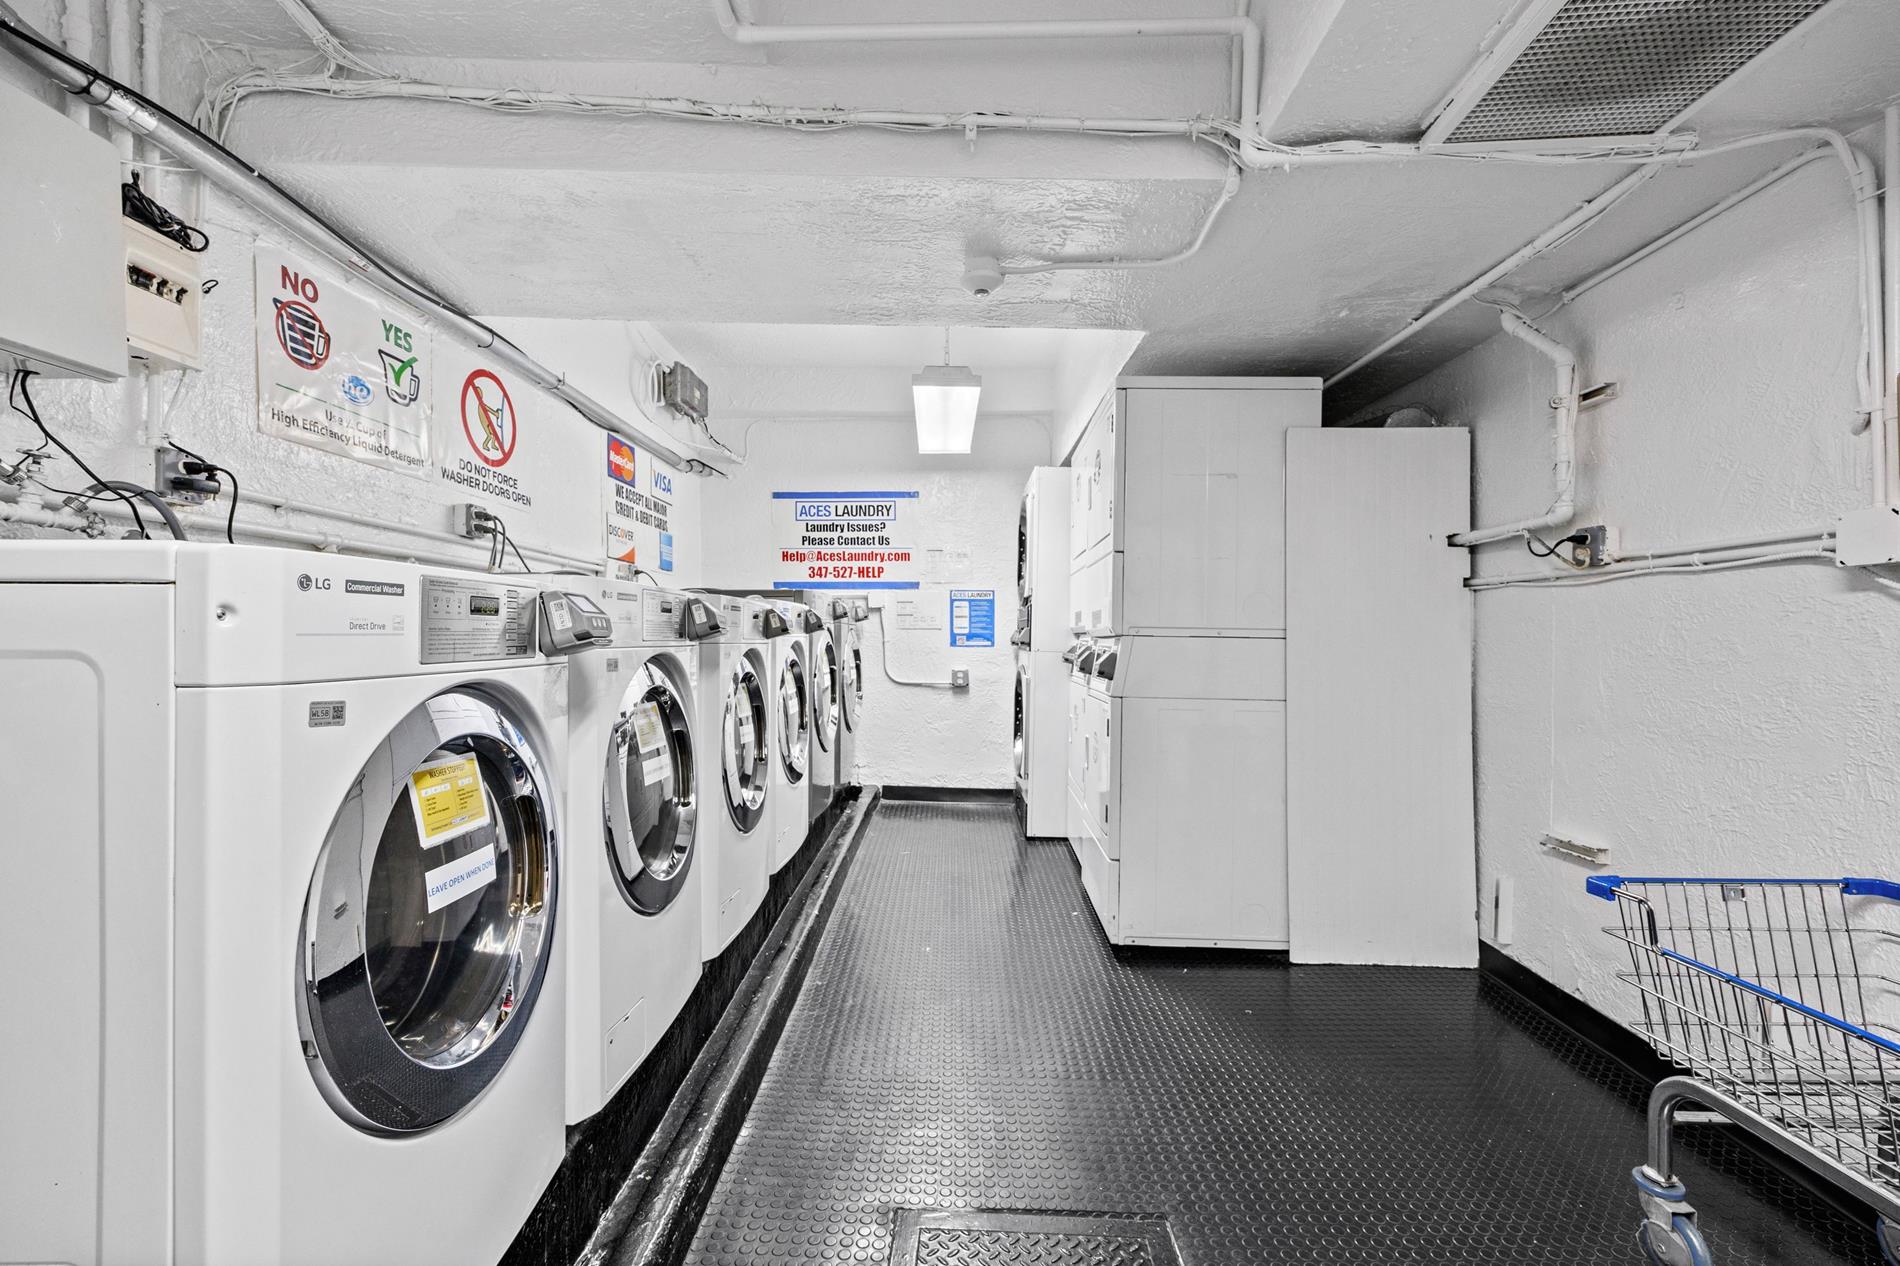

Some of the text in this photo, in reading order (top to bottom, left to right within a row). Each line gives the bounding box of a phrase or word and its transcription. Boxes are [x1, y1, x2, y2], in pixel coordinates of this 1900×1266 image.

[281, 265, 319, 303] NO
[381, 319, 413, 353] YES
[325, 409, 344, 426] Use
[356, 420, 375, 437] Cup
[376, 428, 387, 440] of
[271, 408, 299, 428] High
[302, 418, 351, 447] Efficiency
[353, 434, 383, 455] Liquid
[384, 446, 425, 468] Detergent
[458, 458, 518, 490] DO NOT FORCE
[441, 466, 532, 507] WASHER DOORS OPEN
[653, 471, 672, 496] VISA
[615, 482, 668, 517] WE ACCEPT ALL MAJOR
[615, 500, 634, 520] CREDIT
[639, 510, 652, 527] DEBIT
[799, 504, 892, 517] ACES LAUNDRY
[608, 524, 634, 541] DISCOVER
[805, 521, 886, 533] Laundry Issues?
[801, 535, 890, 546] Please Contact Us
[781, 550, 911, 563] Help@AcesLaundry.com
[808, 566, 885, 579] 347-527-HELP
[315, 577, 331, 590] LG
[346, 582, 404, 594] Commercial Washer
[967, 591, 992, 599] LAUNDRY
[349, 621, 385, 631] Direct Drive
[429, 766, 448, 779] WASHER
[428, 857, 495, 898] LEAVE OPEN WHEN DONE
